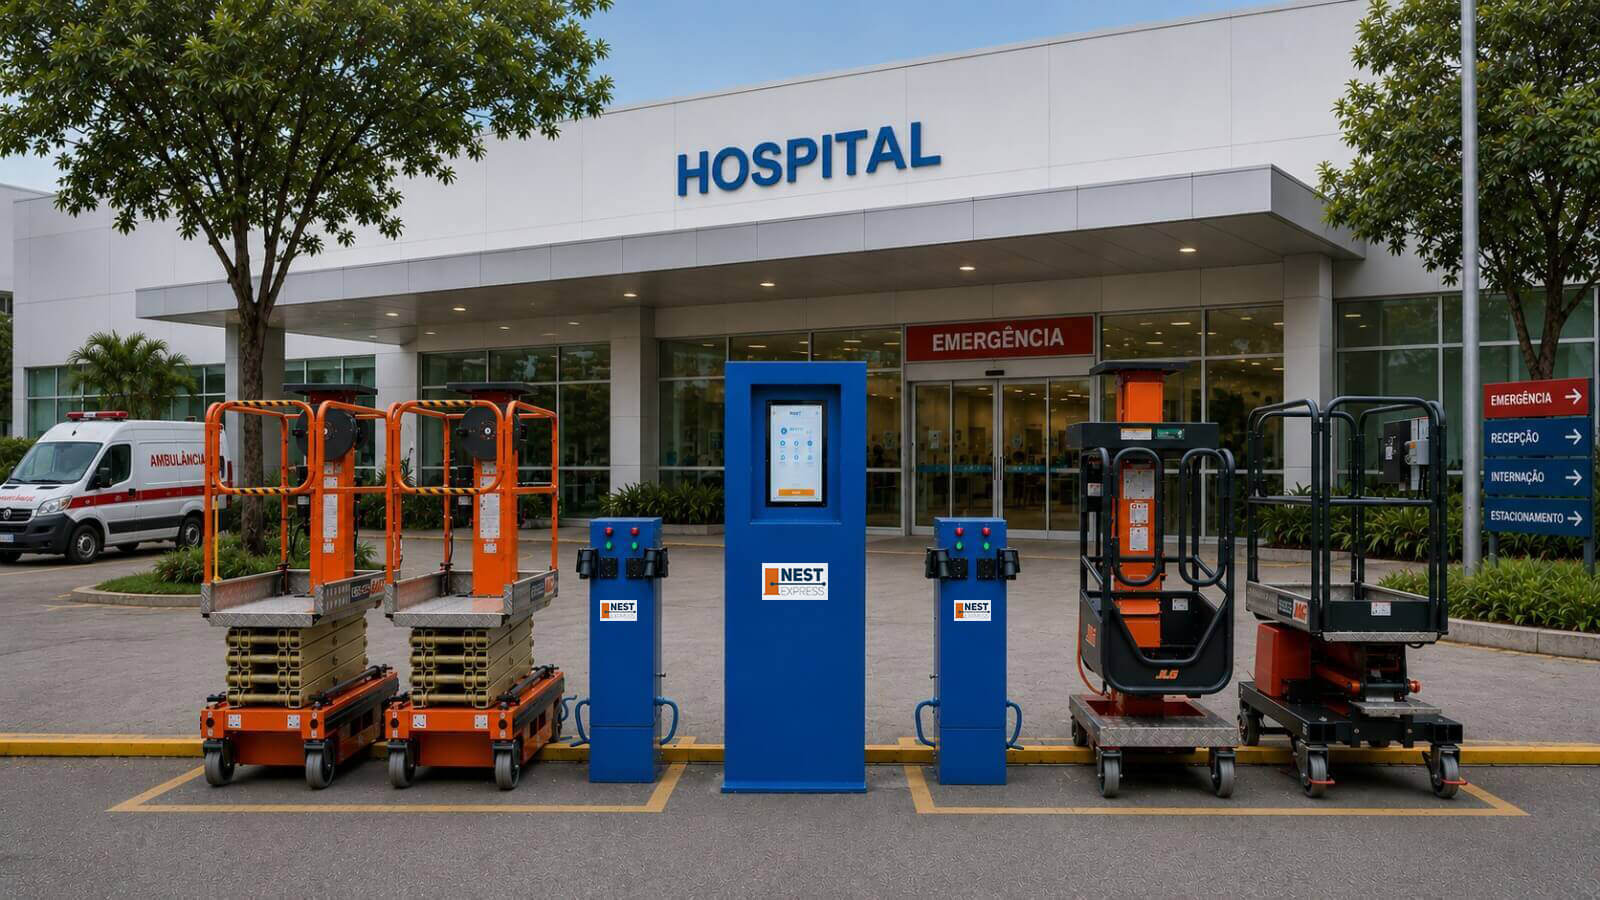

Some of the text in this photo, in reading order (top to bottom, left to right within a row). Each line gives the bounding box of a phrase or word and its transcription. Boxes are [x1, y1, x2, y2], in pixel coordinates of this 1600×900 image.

[678, 122, 941, 196] HOSPITAL
[932, 325, 1064, 352] EMERGÊNCIA
[1491, 391, 1552, 406] EMERGÊNCIA
[1491, 429, 1539, 446] RECEPÇÃO
[1491, 469, 1545, 485] INTERNAÇÃO
[1490, 510, 1564, 523] ESTACIONAMENTO
[781, 568, 824, 581] NEST
[781, 587, 825, 596] EXPRESS
[611, 602, 635, 611] NEST
[964, 602, 989, 611] NEST
